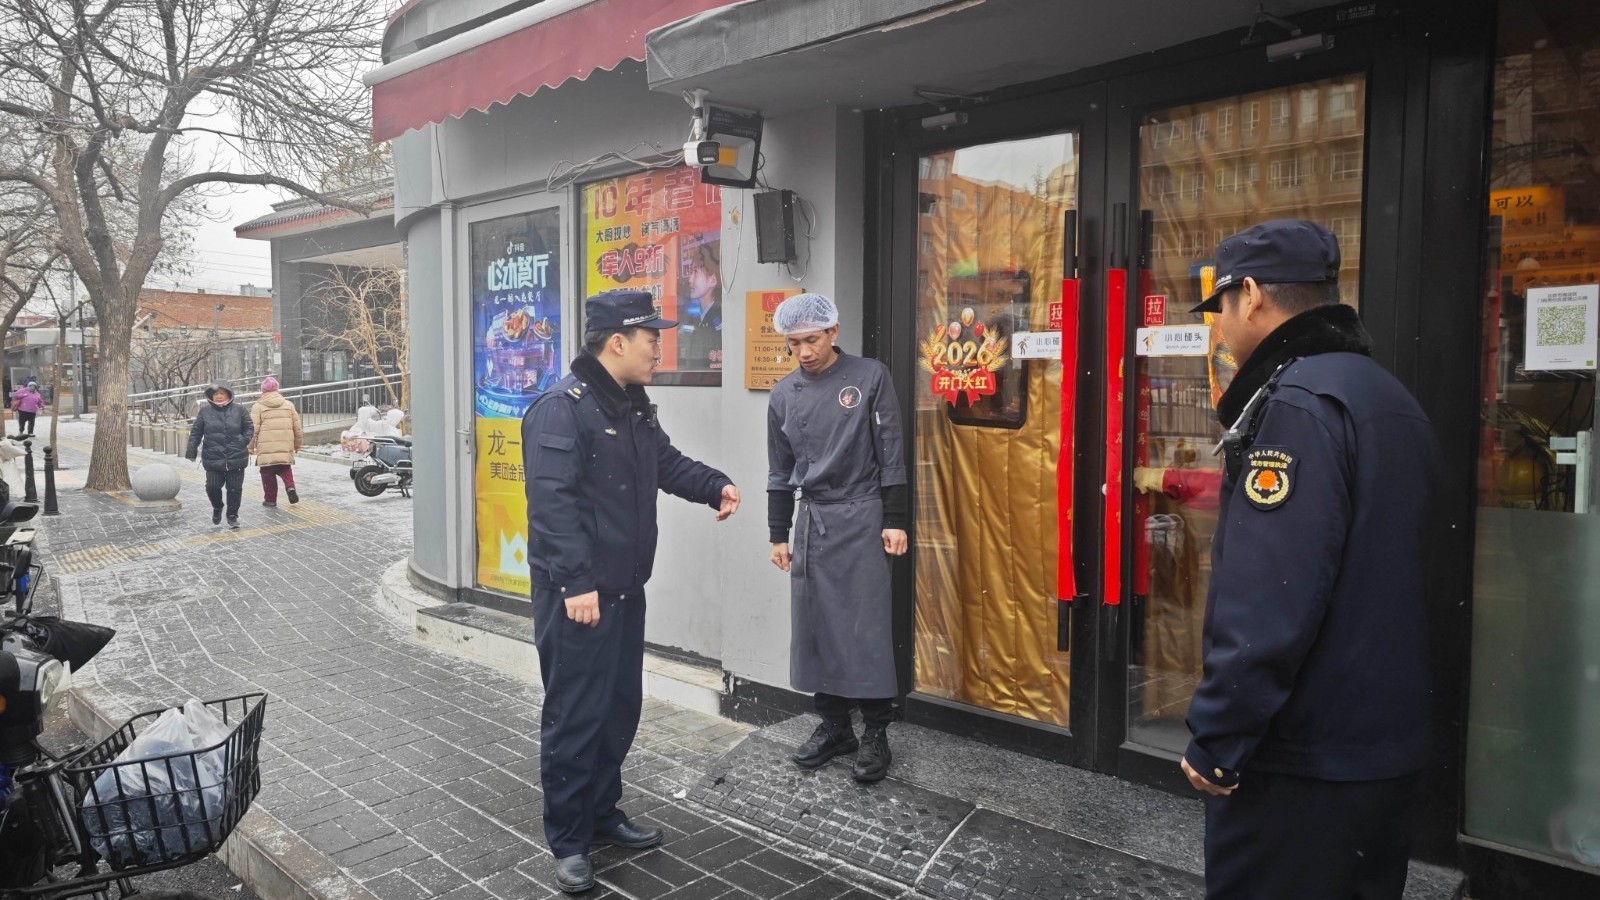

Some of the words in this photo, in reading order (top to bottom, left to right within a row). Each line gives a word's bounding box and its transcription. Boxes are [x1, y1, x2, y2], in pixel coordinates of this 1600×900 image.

[1494, 195, 1533, 209] 可以
[596, 225, 631, 243] 大厨现炒
[601, 245, 664, 277] 军人9折
[487, 253, 550, 291] 心动餐厅
[1147, 299, 1162, 316] 拉
[1165, 332, 1202, 342] 小心碰头
[933, 341, 994, 367] 2026
[939, 376, 988, 391] 开门大红
[1248, 450, 1293, 464] 中华人民共和国
